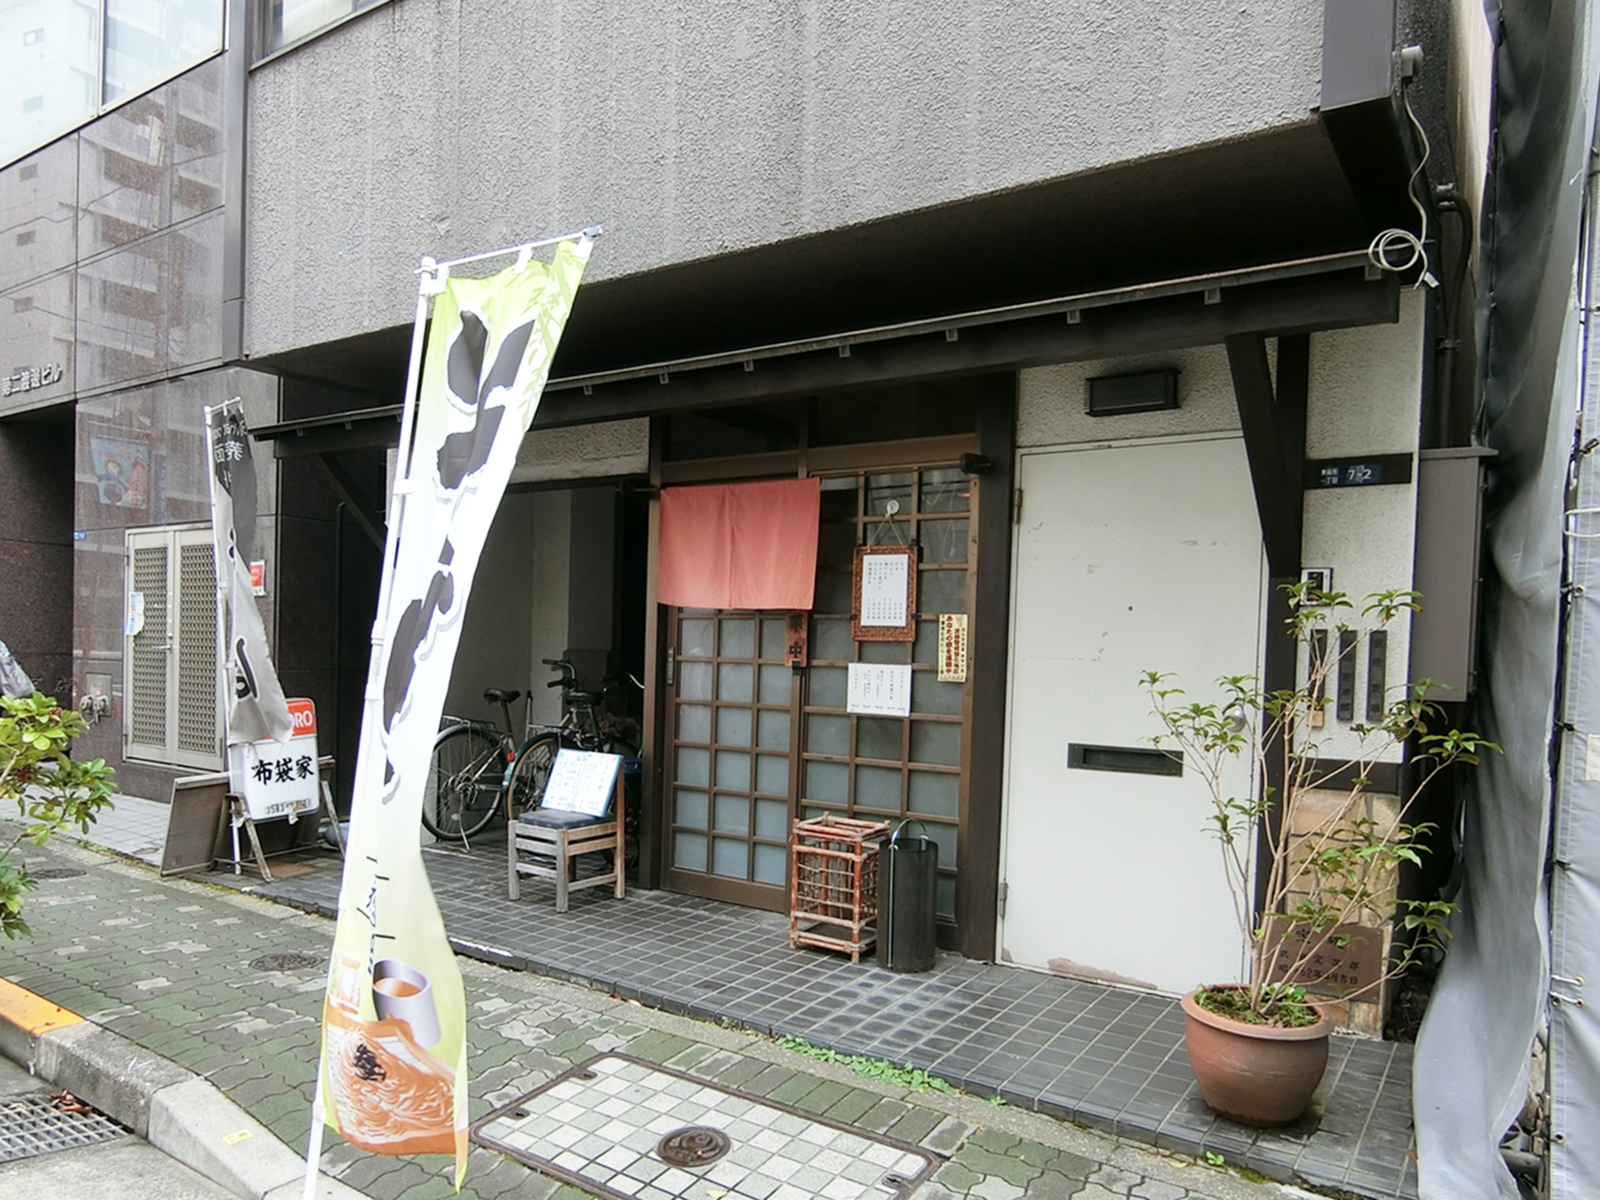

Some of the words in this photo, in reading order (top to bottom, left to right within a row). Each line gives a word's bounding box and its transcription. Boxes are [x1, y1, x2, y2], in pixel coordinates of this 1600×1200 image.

[1347, 468, 1372, 481] 7-2
[251, 755, 315, 785] 布袋家
